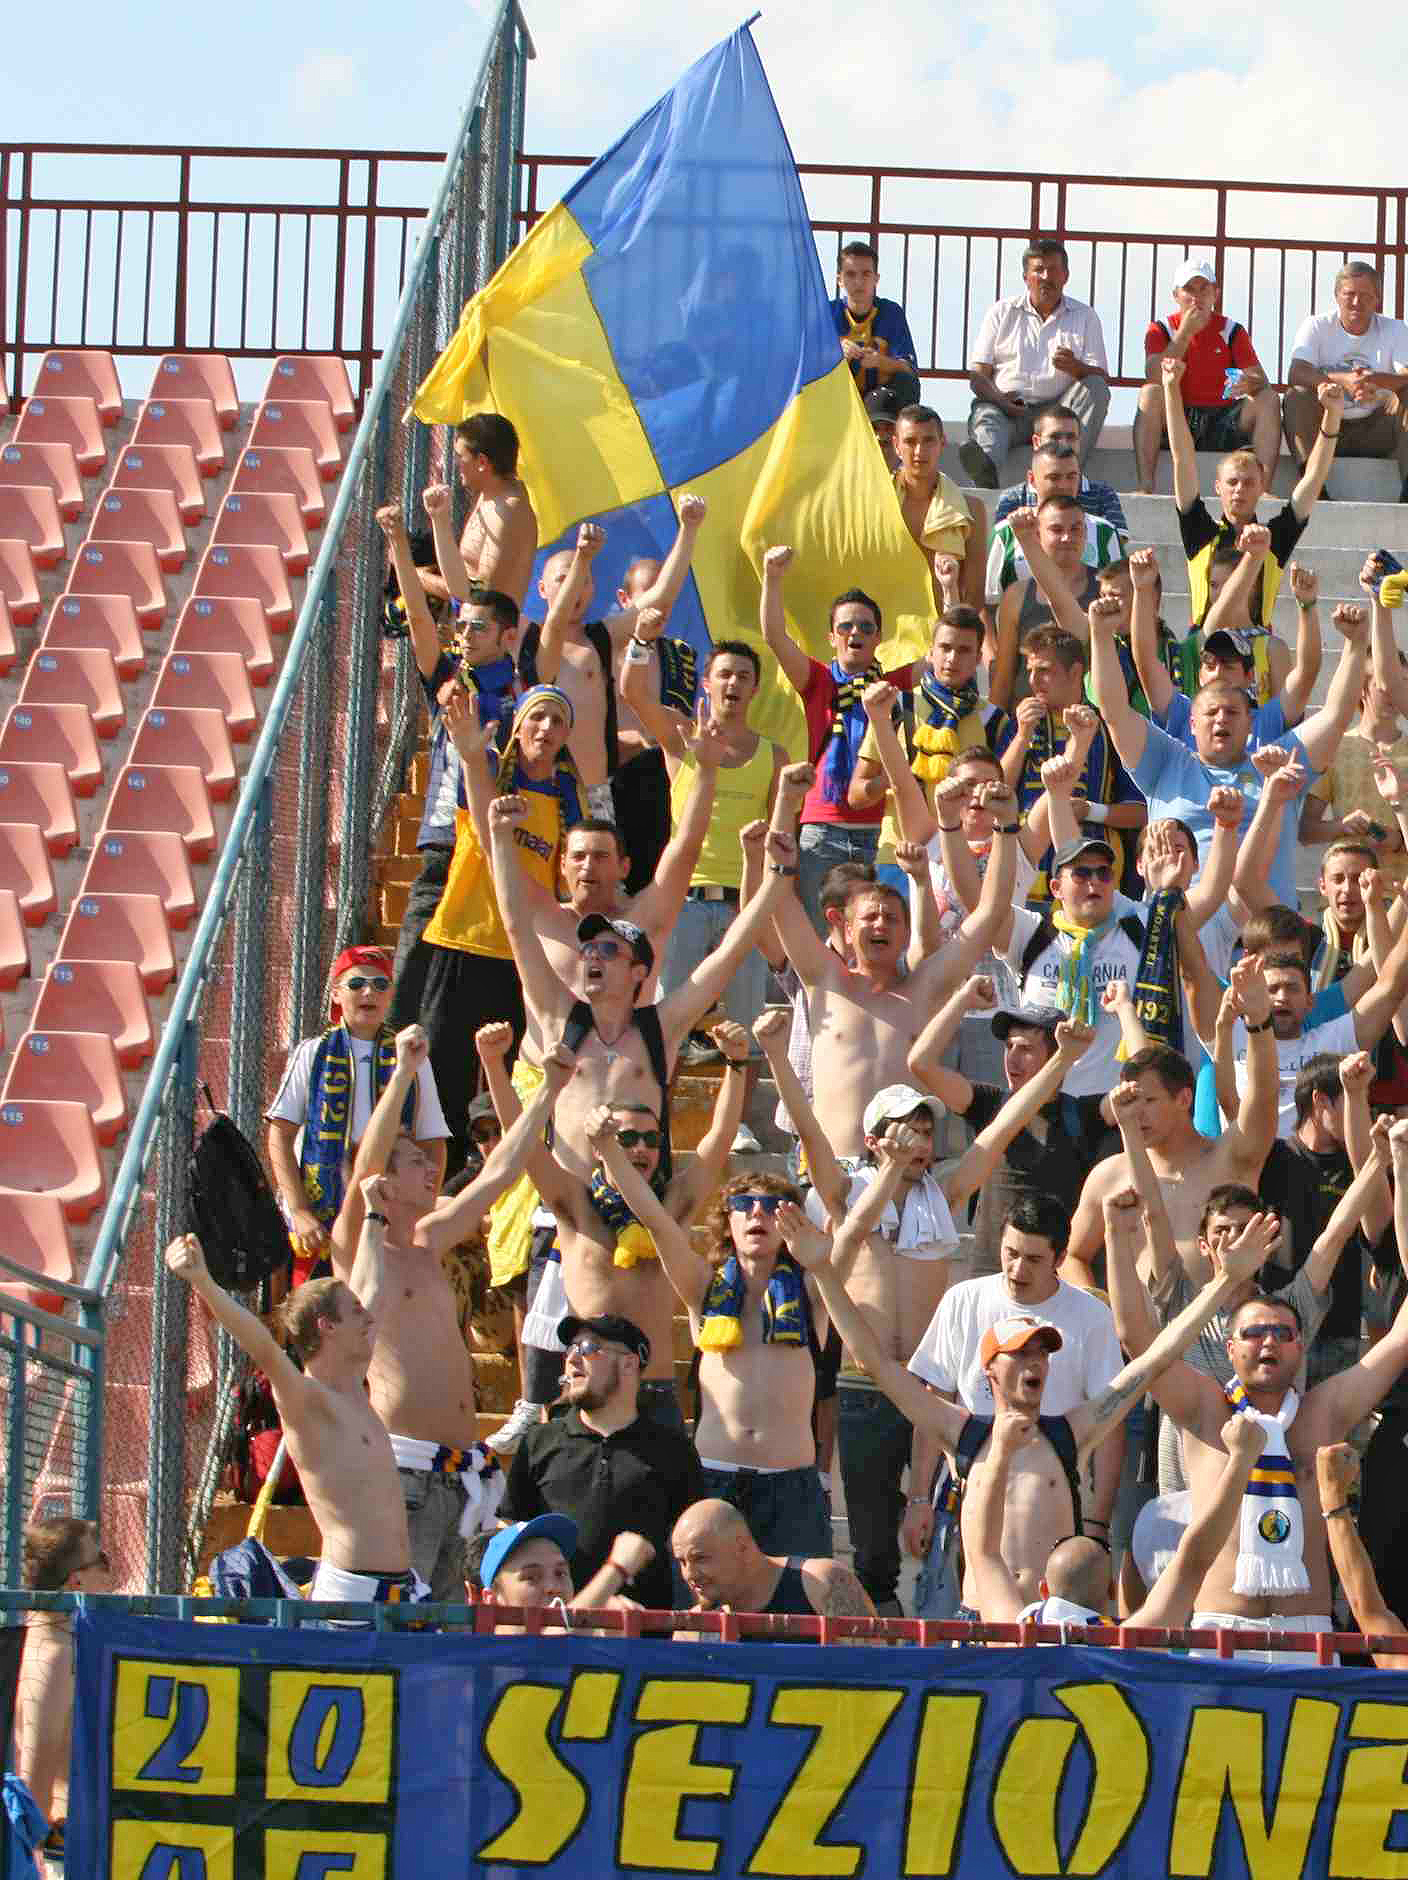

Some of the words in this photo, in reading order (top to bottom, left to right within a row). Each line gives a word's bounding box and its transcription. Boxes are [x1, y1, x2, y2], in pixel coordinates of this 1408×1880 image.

[80, 902, 100, 914] 115
[53, 969, 73, 981] 115
[29, 1039, 49, 1051] 115
[319, 1055, 349, 1141] 1921
[2, 1111, 23, 1123] 115
